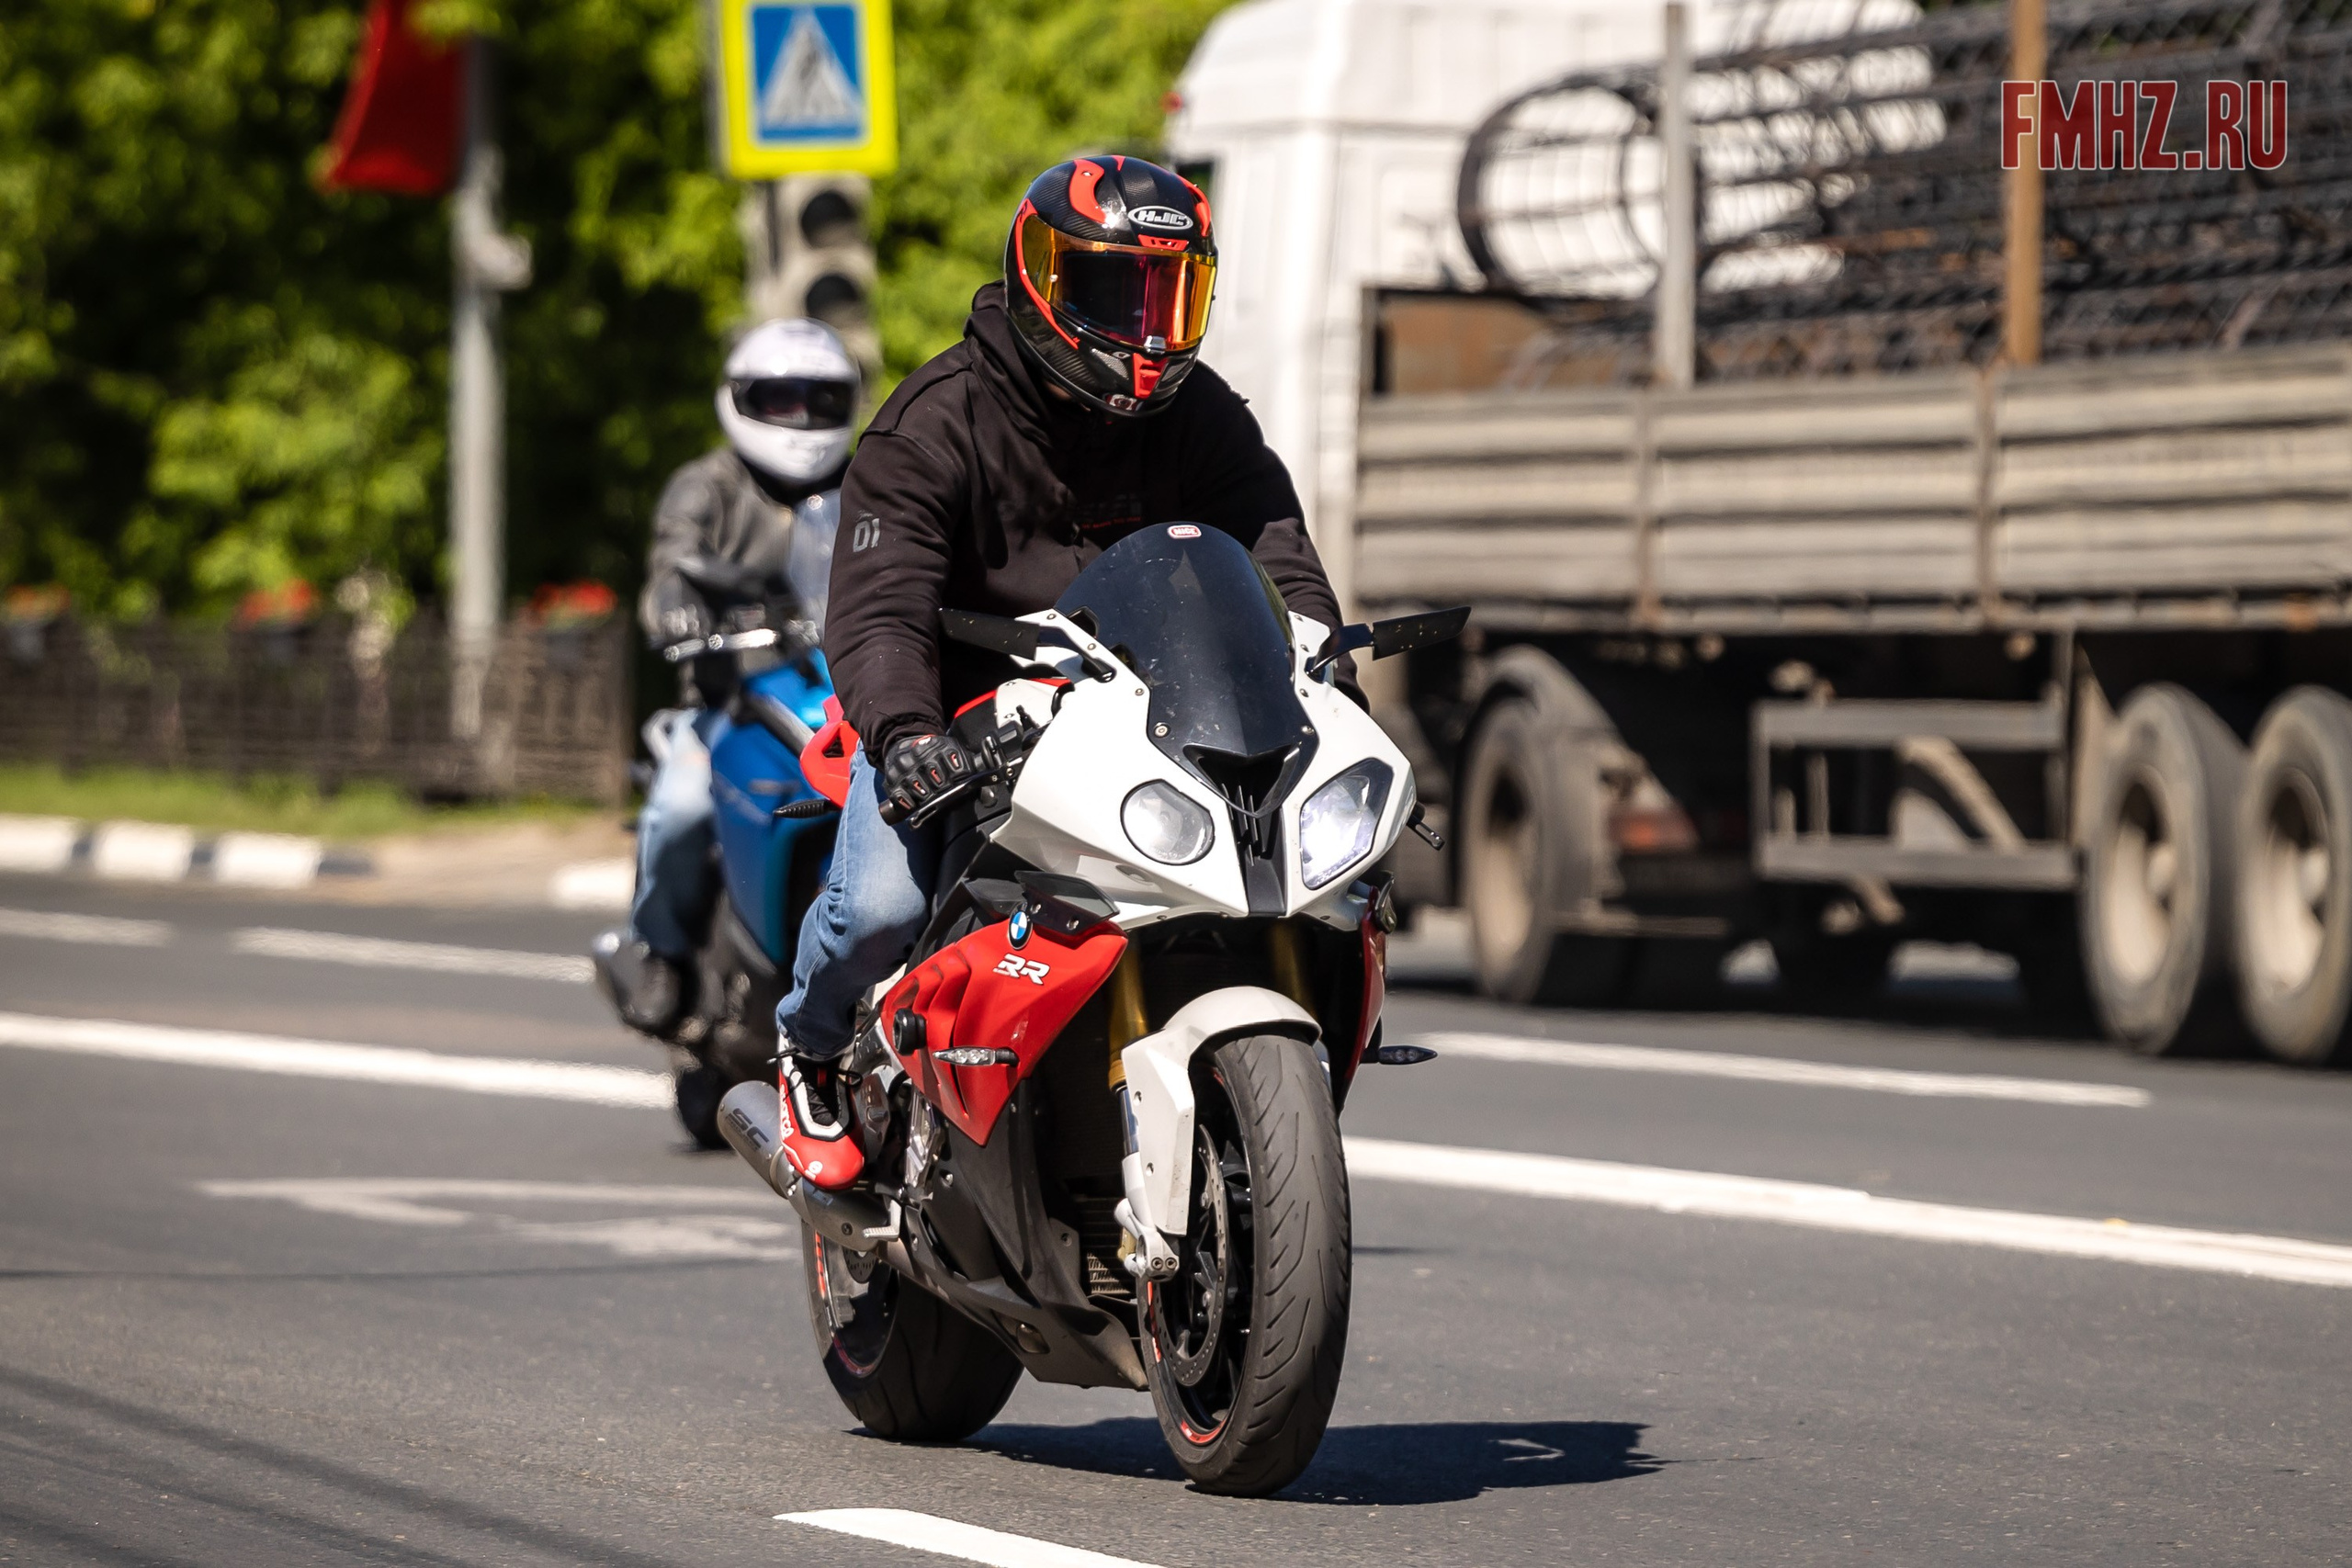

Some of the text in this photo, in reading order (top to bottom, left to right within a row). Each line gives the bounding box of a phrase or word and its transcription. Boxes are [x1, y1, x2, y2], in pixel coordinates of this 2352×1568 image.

[1136, 209, 1188, 227] HJC
[993, 953, 1050, 985] RR
[727, 1108, 770, 1148] SC
